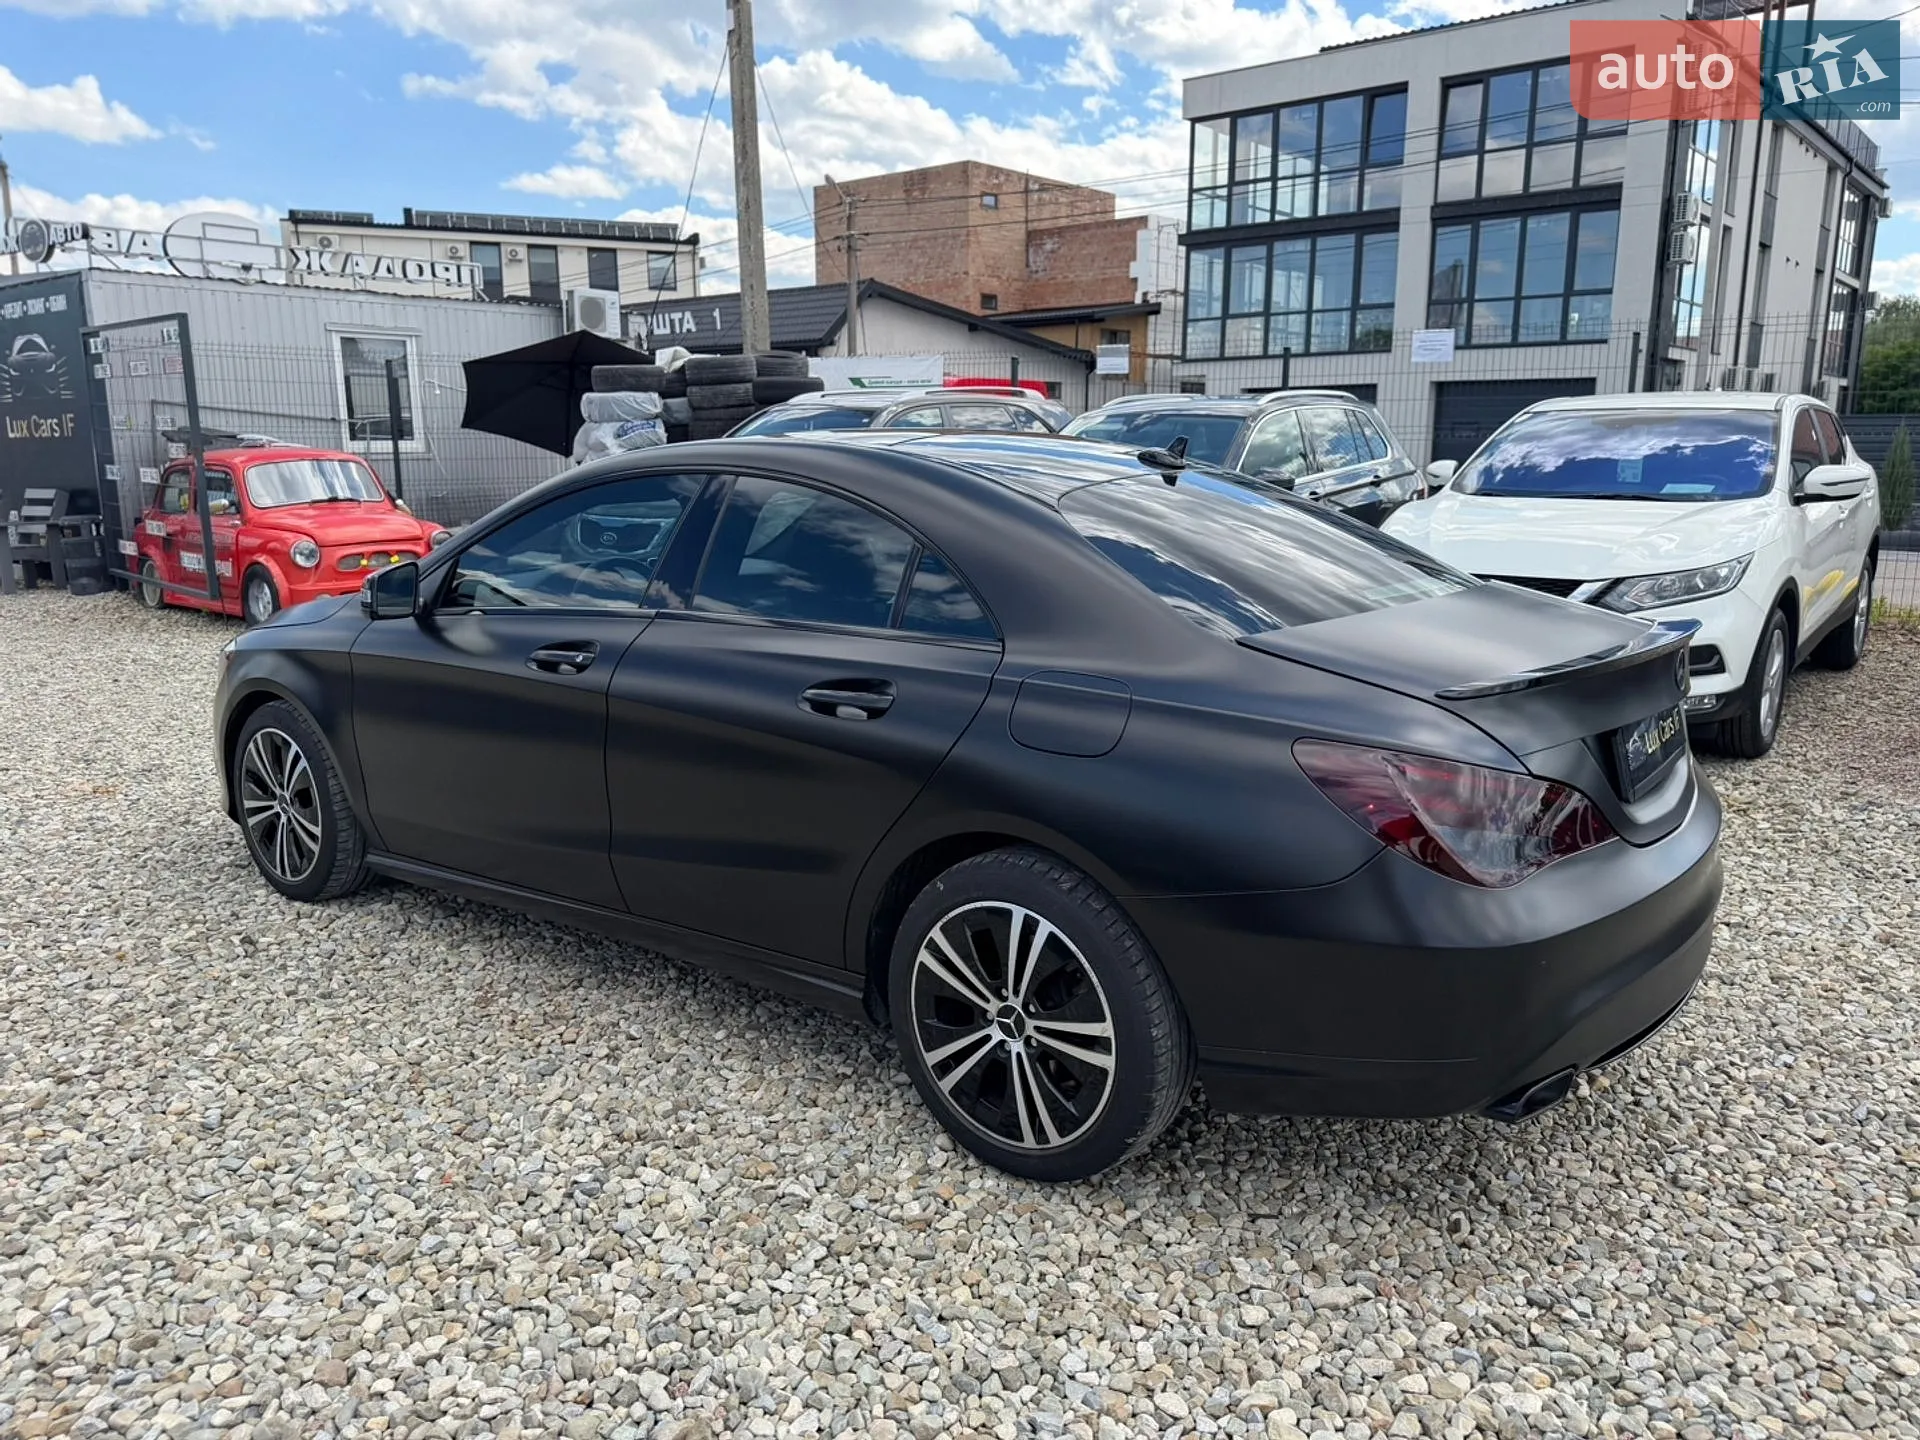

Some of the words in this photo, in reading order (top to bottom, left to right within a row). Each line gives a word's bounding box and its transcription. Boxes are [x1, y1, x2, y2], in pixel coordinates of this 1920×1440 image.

[50, 223, 83, 245] АВТО
[648, 311, 696, 336] ШТА
[712, 308, 722, 331] 1
[6, 415, 30, 438] Lux
[31, 414, 60, 438] Cars
[62, 413, 75, 437] IF
[1644, 728, 1661, 754] Lux
